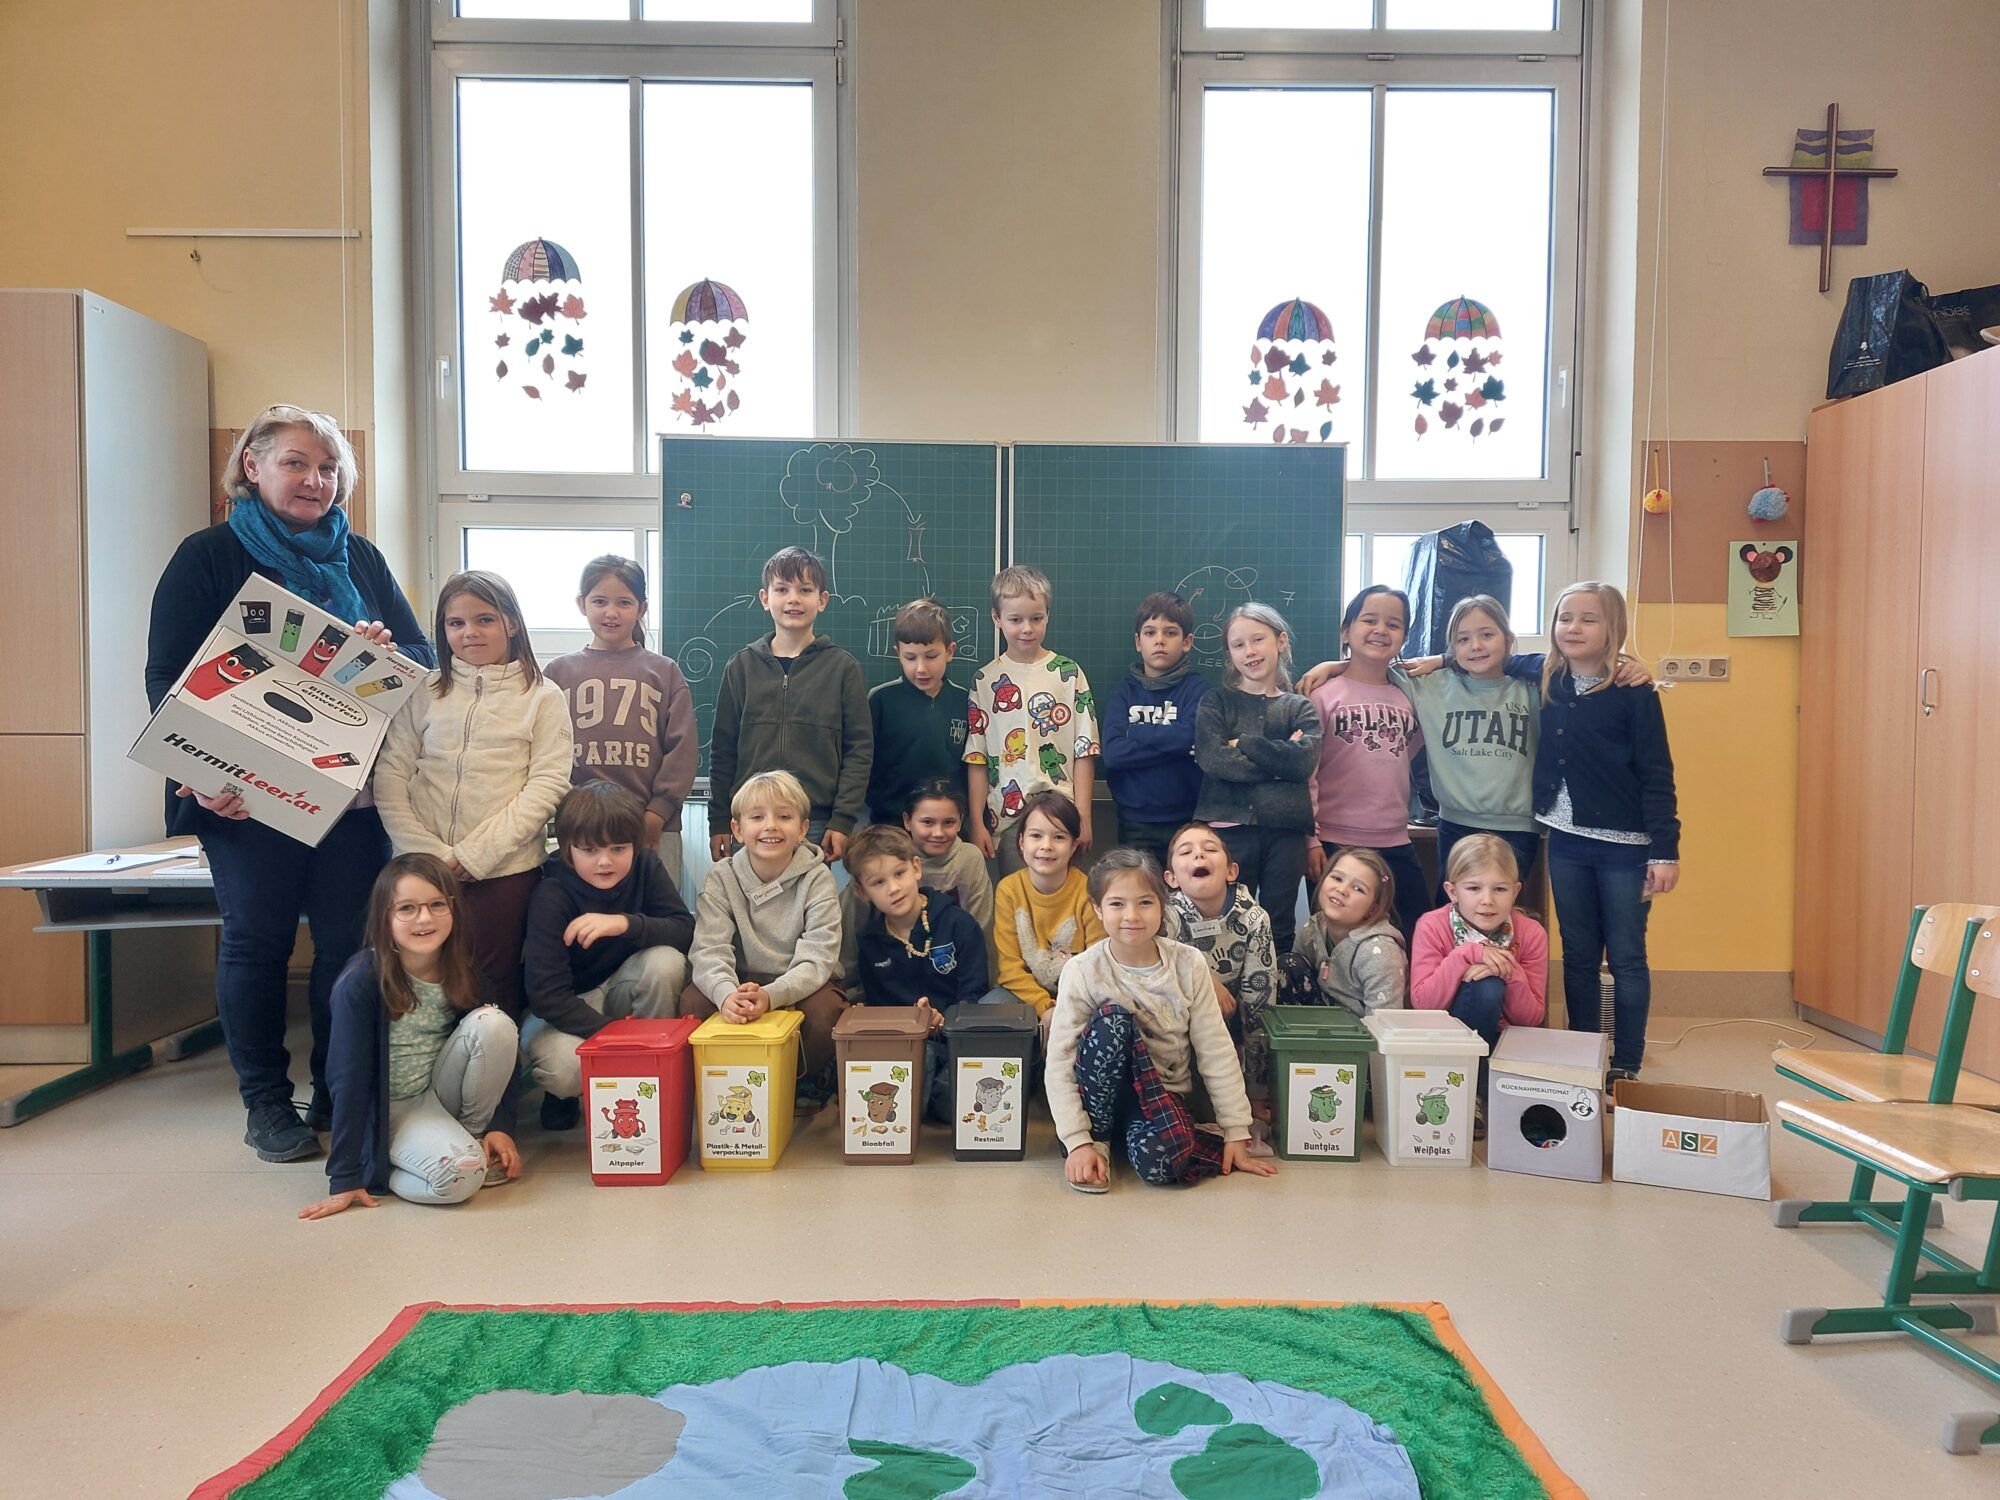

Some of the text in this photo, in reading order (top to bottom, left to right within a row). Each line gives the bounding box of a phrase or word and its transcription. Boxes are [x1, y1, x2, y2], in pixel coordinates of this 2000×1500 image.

[1279, 590, 1296, 606] 7
[385, 656, 410, 671] Hermit
[301, 688, 362, 722] einwerfen!
[309, 685, 360, 714] Bitte hier
[561, 678, 662, 737] 975
[1505, 702, 1530, 714] USA
[1442, 710, 1530, 758] UTAH
[573, 741, 650, 768] PARIS
[1451, 746, 1514, 761] Salt Lake City
[163, 732, 322, 815] HermitLeer.at
[1501, 1083, 1570, 1096] RÜCKNAHMEAUTOMAT
[973, 1135, 1005, 1143] Restmüll
[1303, 1141, 1340, 1152] Buntglas
[1663, 1130, 1717, 1153] ASZ
[711, 1149, 761, 1157] verpackungen
[1413, 1145, 1451, 1156] Weißglas
[608, 1160, 645, 1168] Altpapier
